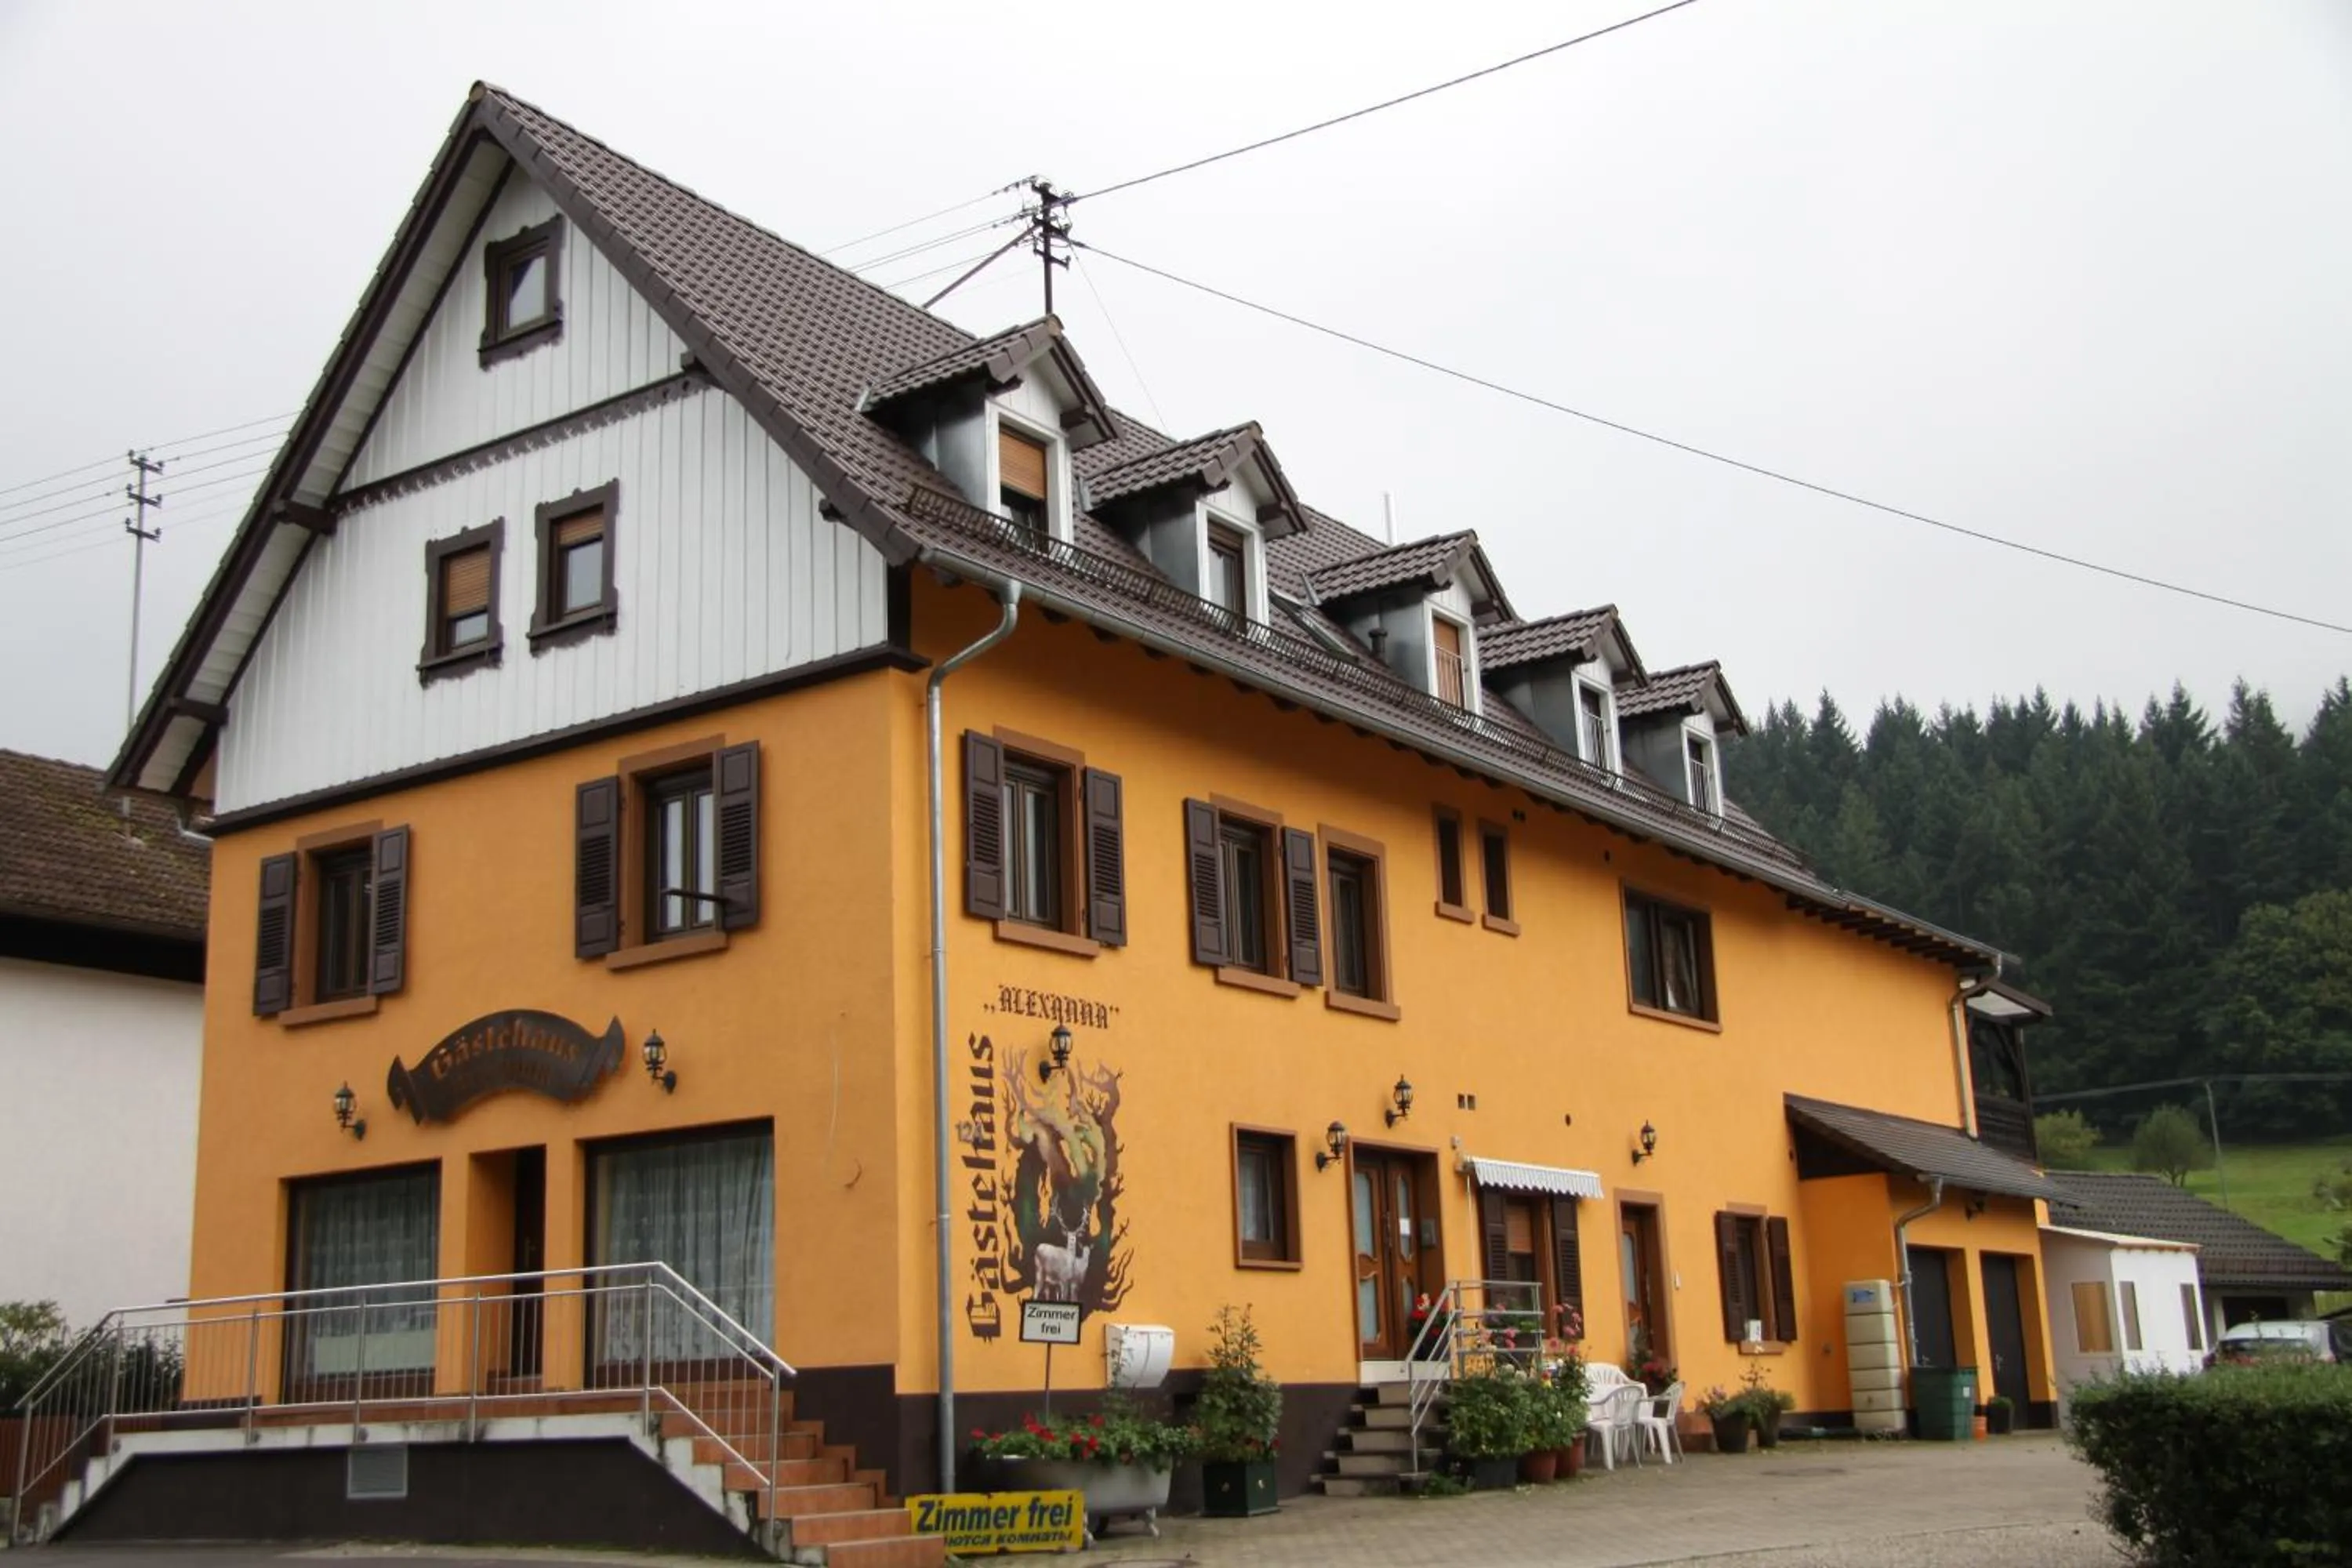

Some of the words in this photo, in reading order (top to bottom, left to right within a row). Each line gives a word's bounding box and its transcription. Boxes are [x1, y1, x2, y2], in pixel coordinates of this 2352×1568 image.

[962, 1031, 1001, 1344] Gästehaus
[1027, 1306, 1076, 1320] Zimmer
[1040, 1322, 1062, 1334] frei
[916, 1500, 1020, 1531] Zimmer
[1029, 1495, 1073, 1527] frei
